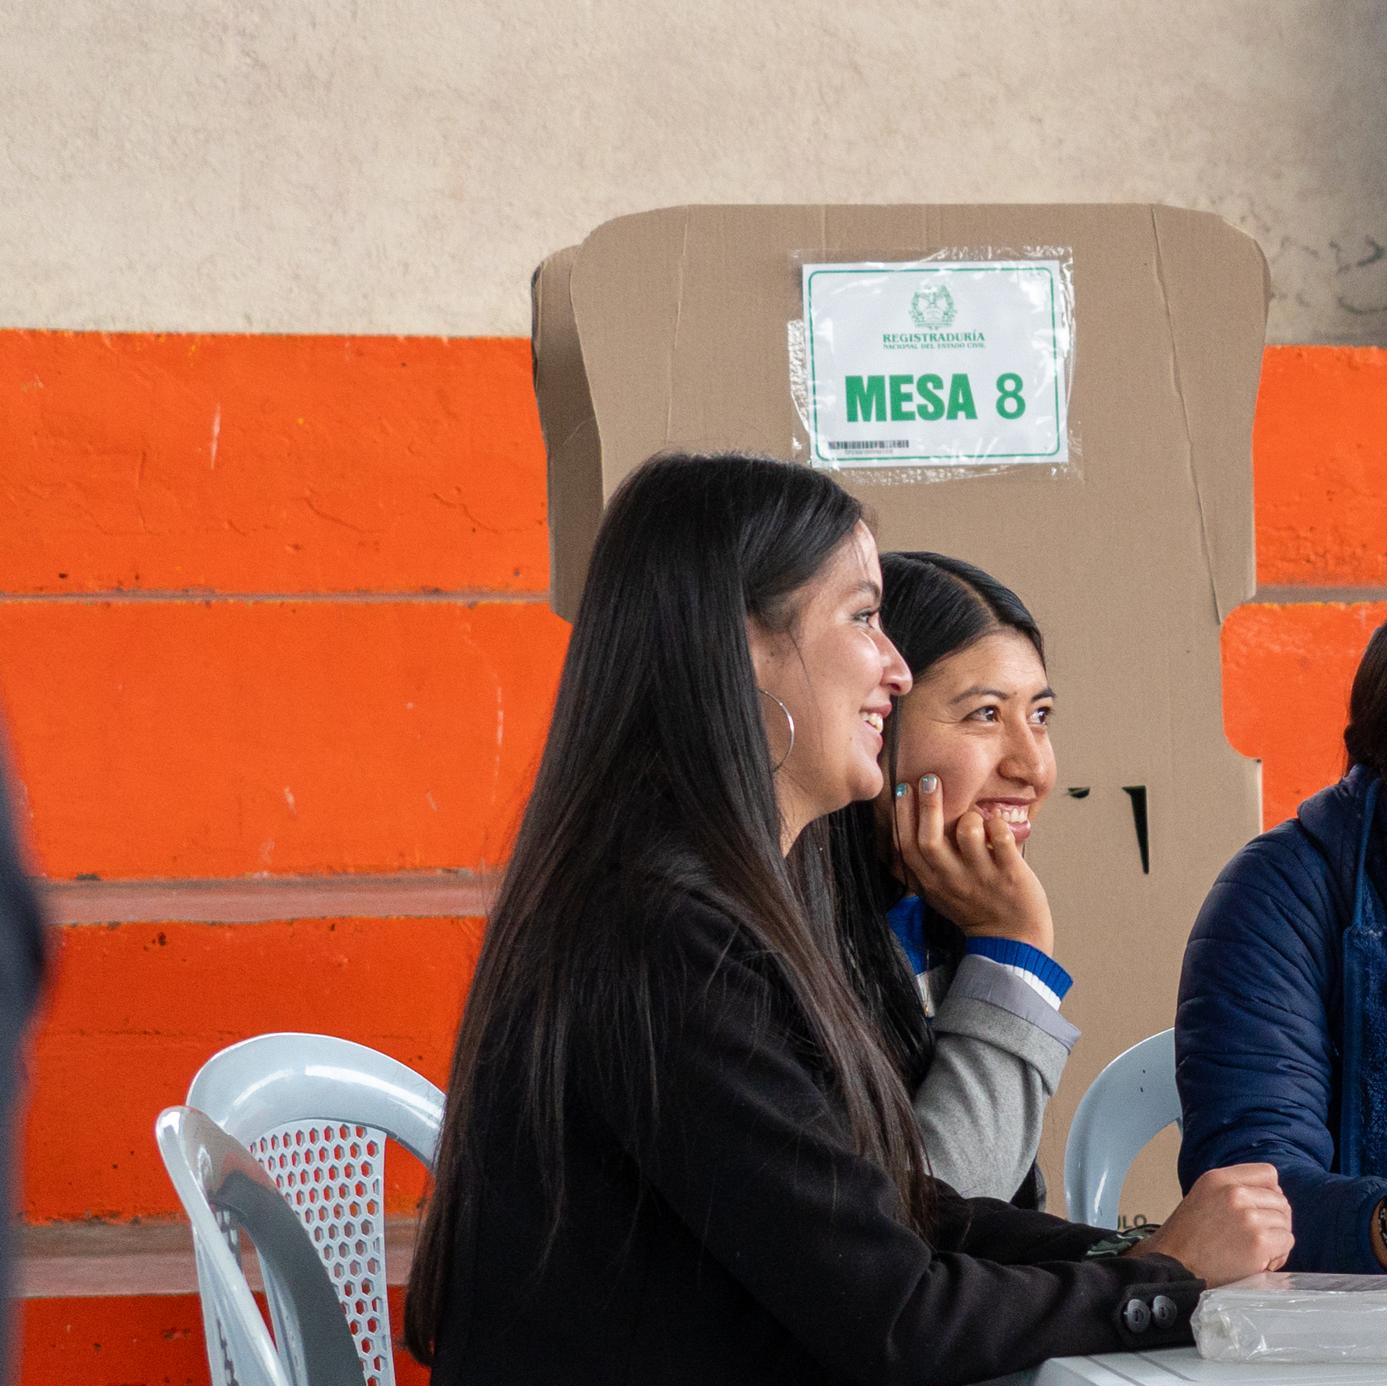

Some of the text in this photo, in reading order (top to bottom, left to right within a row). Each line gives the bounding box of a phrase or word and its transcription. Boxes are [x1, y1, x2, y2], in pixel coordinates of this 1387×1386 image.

[882, 329, 985, 343] REGISTRADURÍA
[845, 372, 1026, 422] MESA 8
